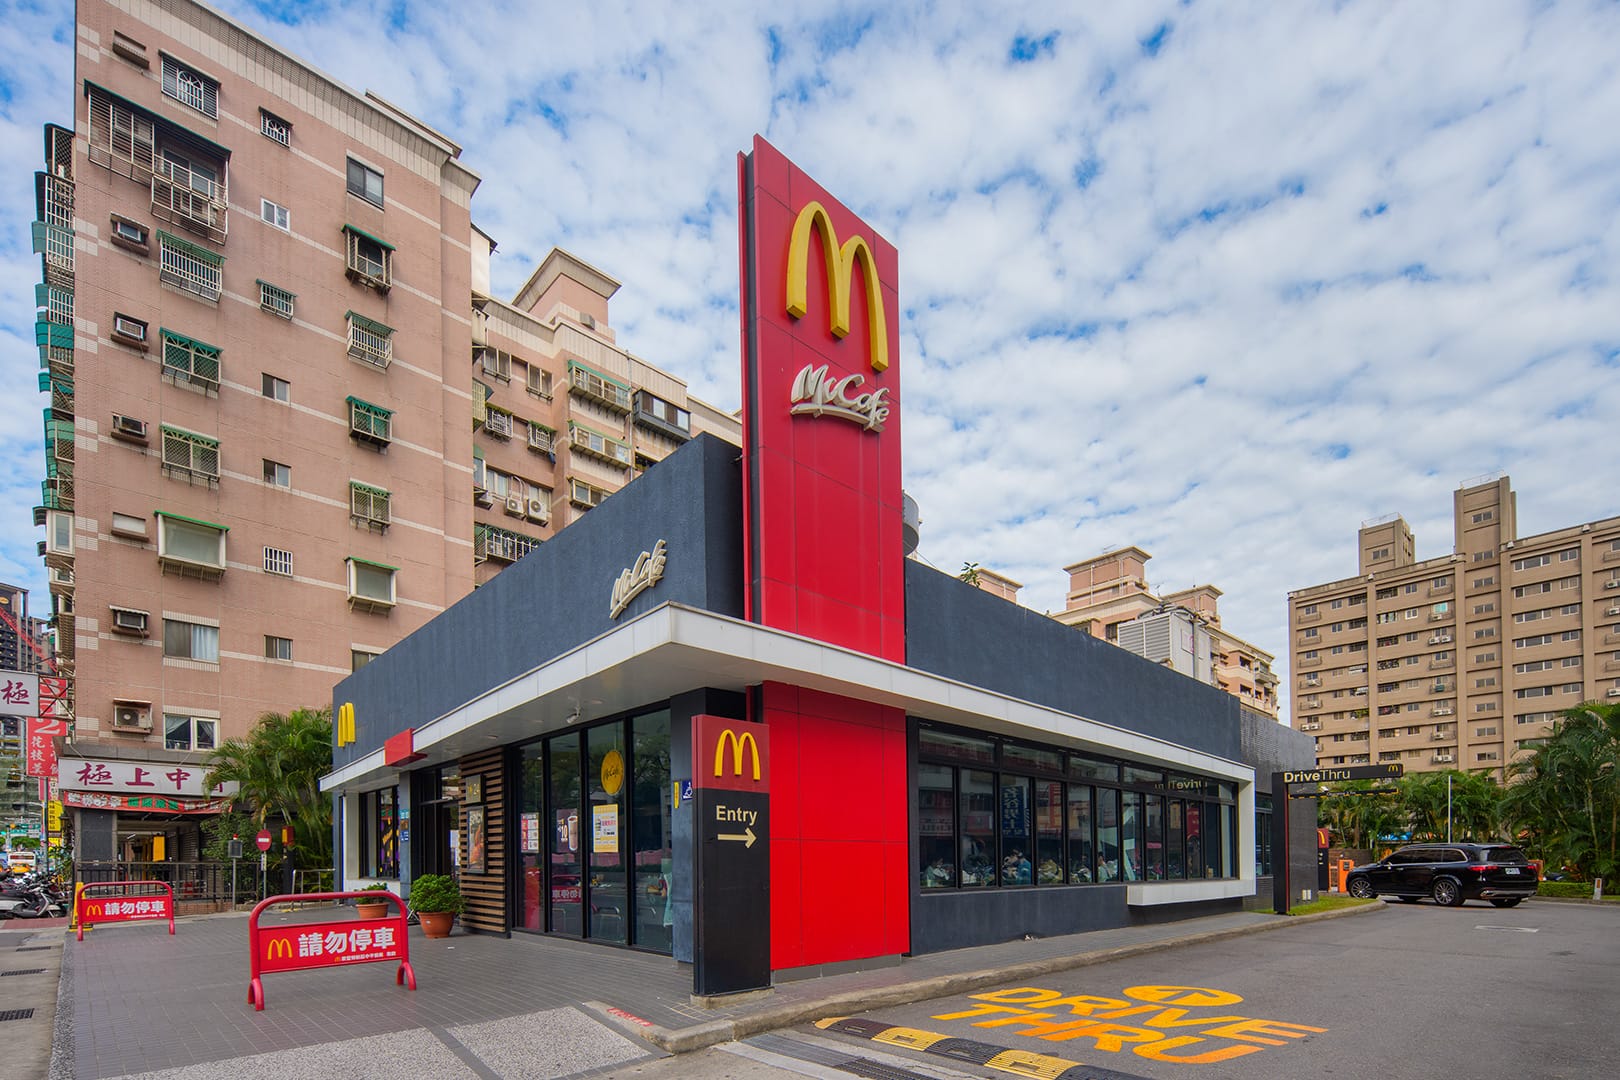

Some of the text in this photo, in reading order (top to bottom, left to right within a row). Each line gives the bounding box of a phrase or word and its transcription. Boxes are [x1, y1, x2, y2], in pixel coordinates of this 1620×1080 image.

[1, 679, 30, 705] 極
[1283, 769, 1351, 783] DriveThru
[716, 804, 757, 826] Entry
[104, 901, 165, 916] 請勿停車
[298, 927, 396, 957] 請勿停車
[968, 986, 1329, 1046] DRIVE
[930, 1003, 1265, 1064] THRU
